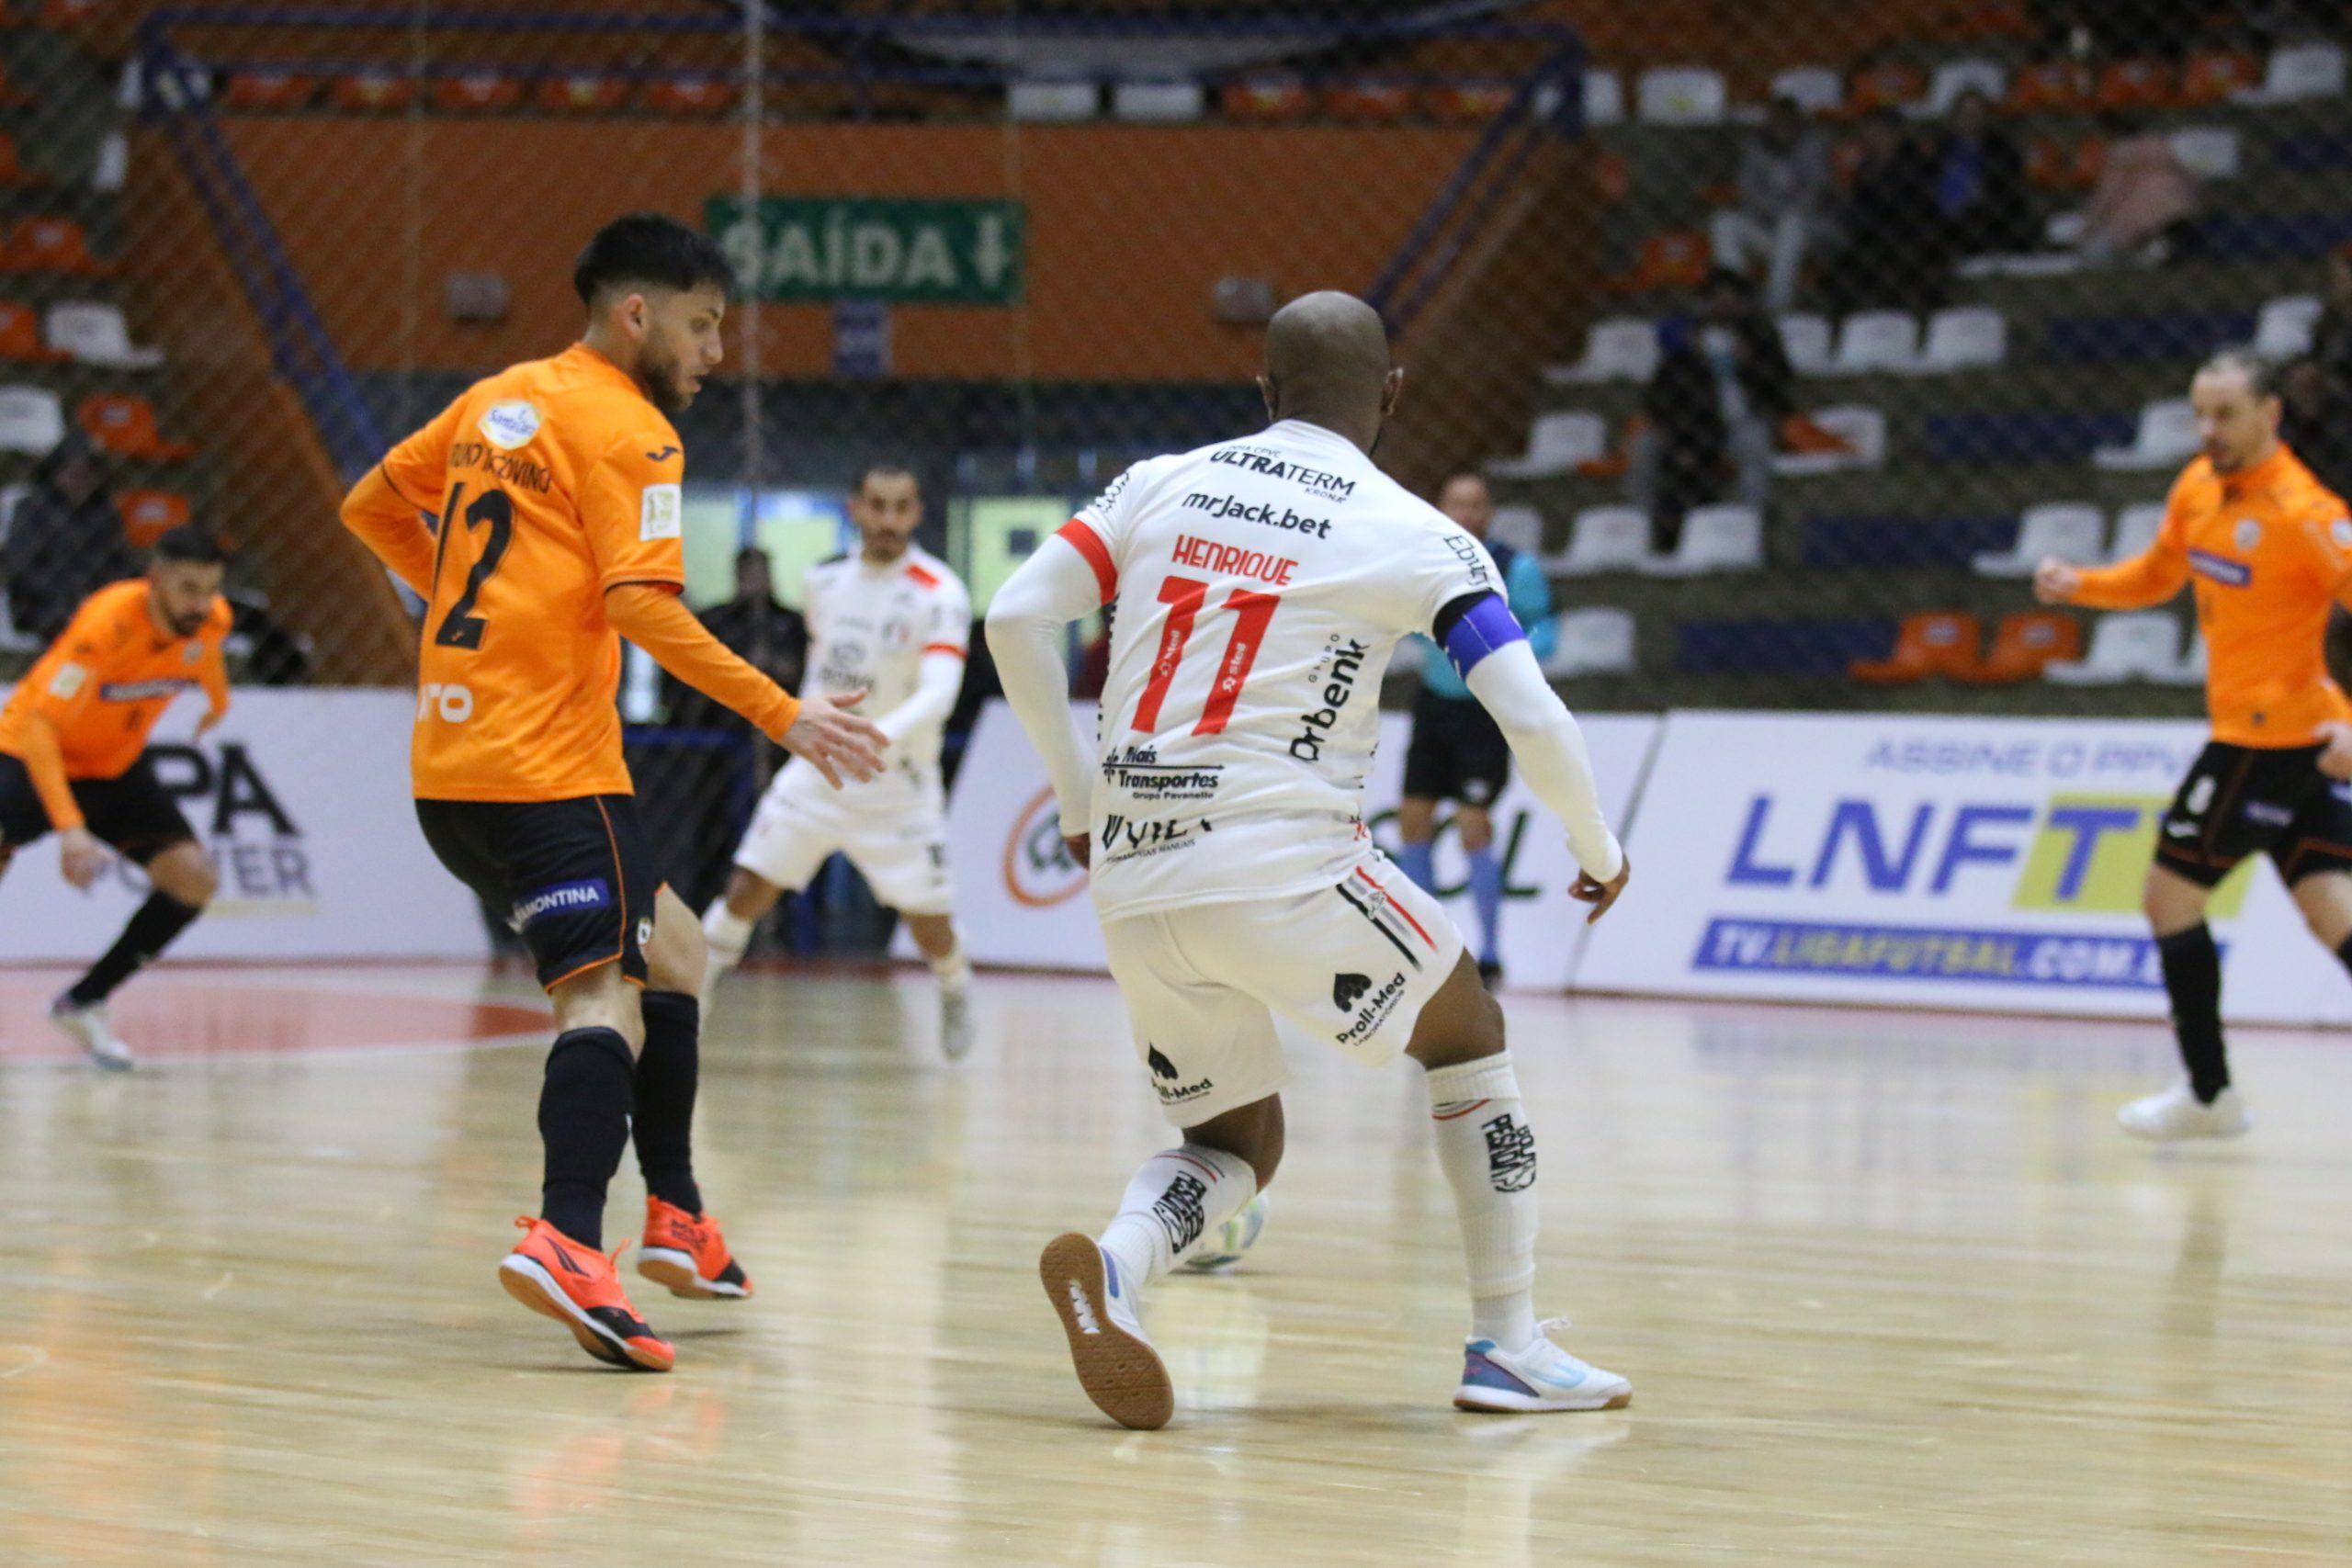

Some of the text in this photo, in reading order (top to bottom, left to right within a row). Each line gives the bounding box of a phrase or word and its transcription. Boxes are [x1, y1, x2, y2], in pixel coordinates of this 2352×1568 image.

[722, 204, 957, 288] SAÍDA
[1210, 450, 1356, 496] ULTRATERM
[1182, 492, 1332, 540] mrJack.bet
[1171, 534, 1299, 586] HENRIQUE
[1131, 575, 1281, 737] 11
[1118, 770, 1219, 793] Transportes
[1866, 738, 2035, 777] ASSINE
[2045, 740, 2084, 777] O
[1725, 795, 2174, 902] LNFT
[1335, 972, 1407, 1044] Proll-Med
